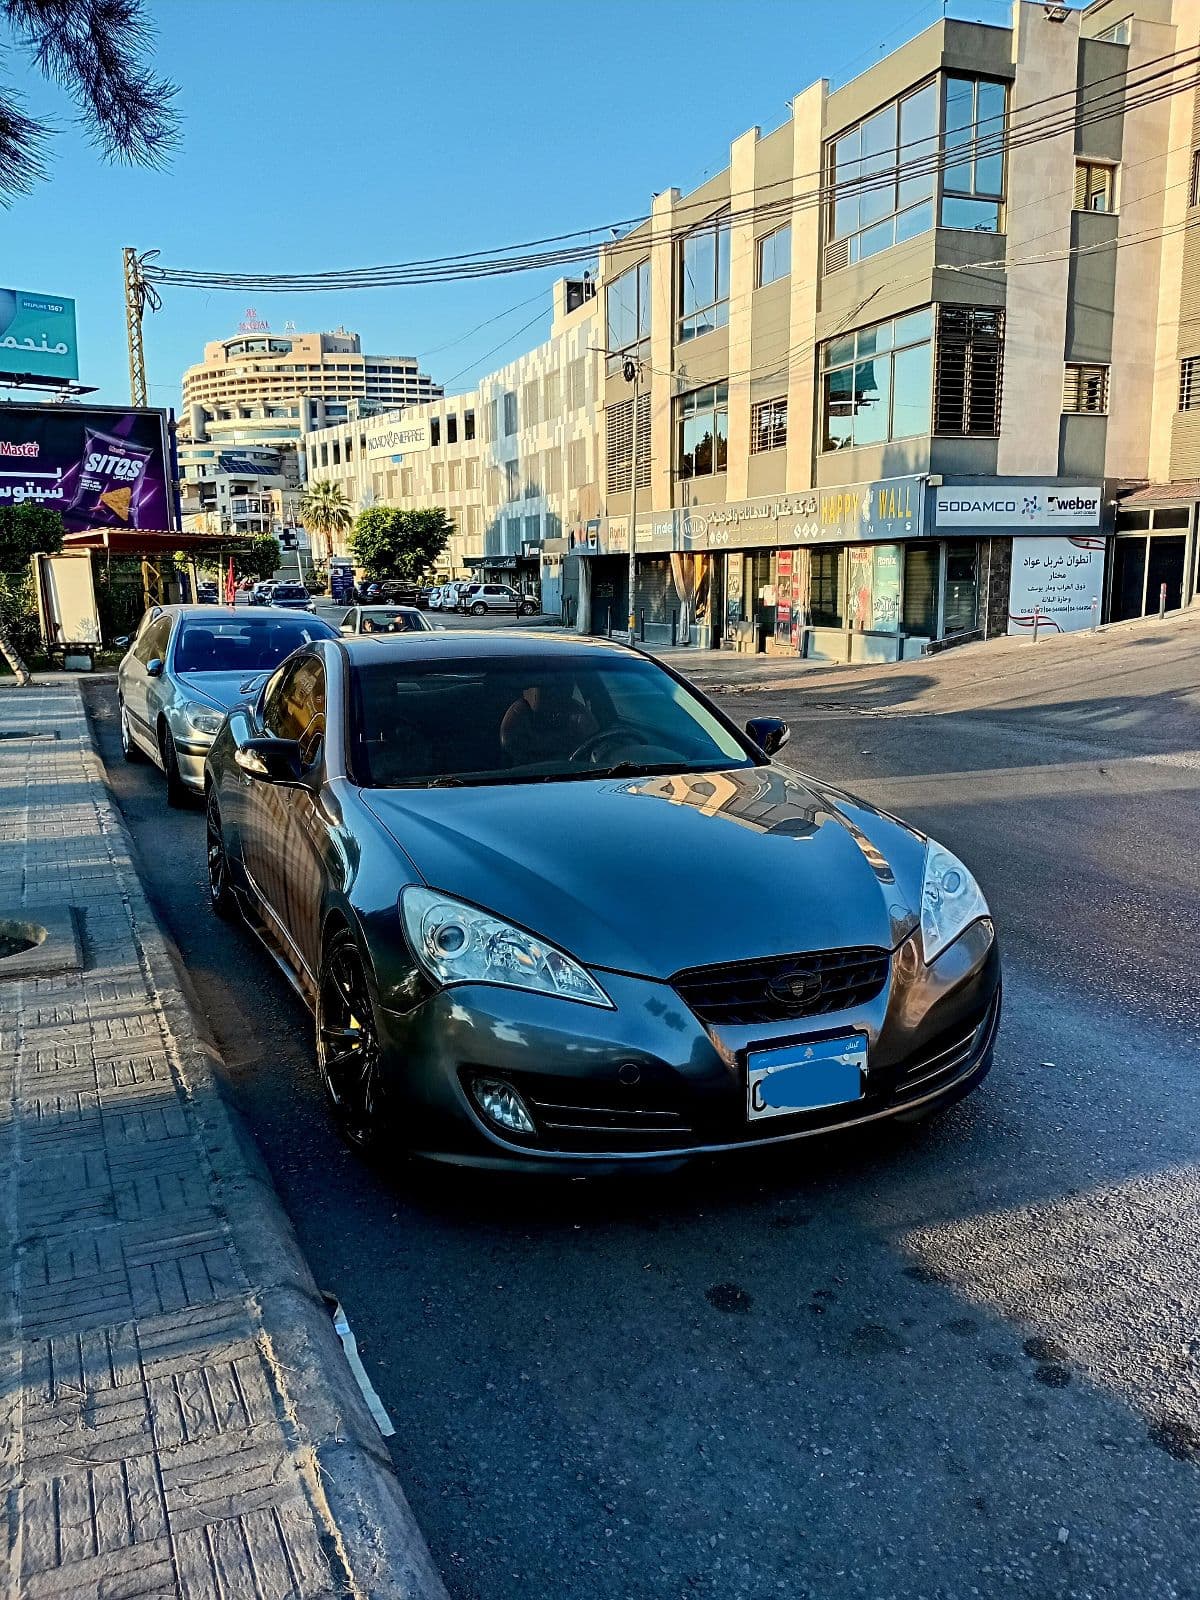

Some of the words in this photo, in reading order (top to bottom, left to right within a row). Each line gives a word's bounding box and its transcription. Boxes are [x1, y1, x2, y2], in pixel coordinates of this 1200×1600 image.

[23, 301, 47, 310] HELPLINE
[47, 304, 63, 312] 1567
[0, 441, 40, 457] Master
[84, 453, 144, 478] SITOS
[821, 491, 859, 525] HAPPY
[879, 485, 912, 520] WALL
[938, 501, 1016, 512] SODAMCO
[1057, 496, 1097, 510] weber
[1023, 556, 1041, 569] عواد
[1044, 555, 1064, 568] شربل
[1066, 551, 1092, 567] أنطوان
